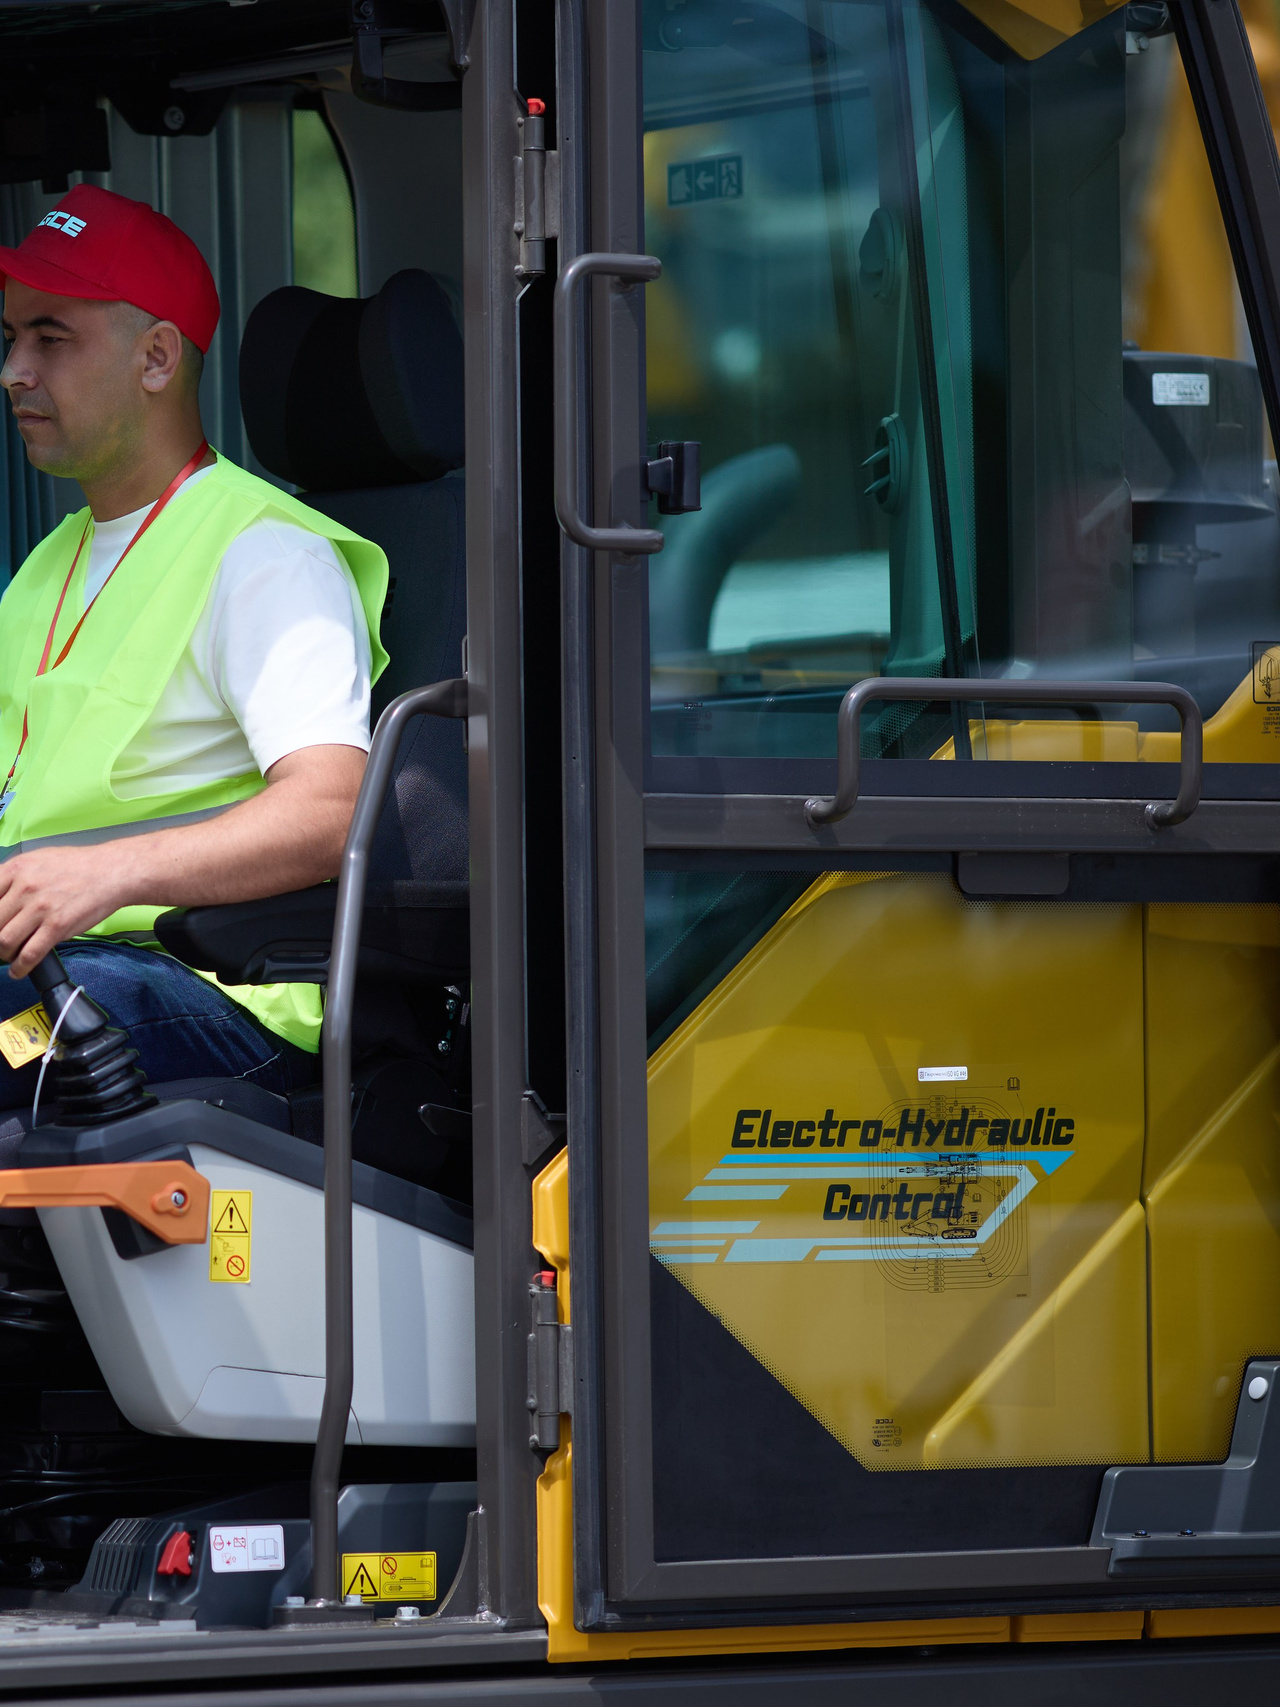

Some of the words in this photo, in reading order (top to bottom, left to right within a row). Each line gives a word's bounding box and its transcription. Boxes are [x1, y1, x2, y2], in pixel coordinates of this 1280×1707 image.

[37, 210, 88, 238] GCE
[730, 1107, 1075, 1148] Electro-Hydraulic
[822, 1182, 967, 1221] Control
